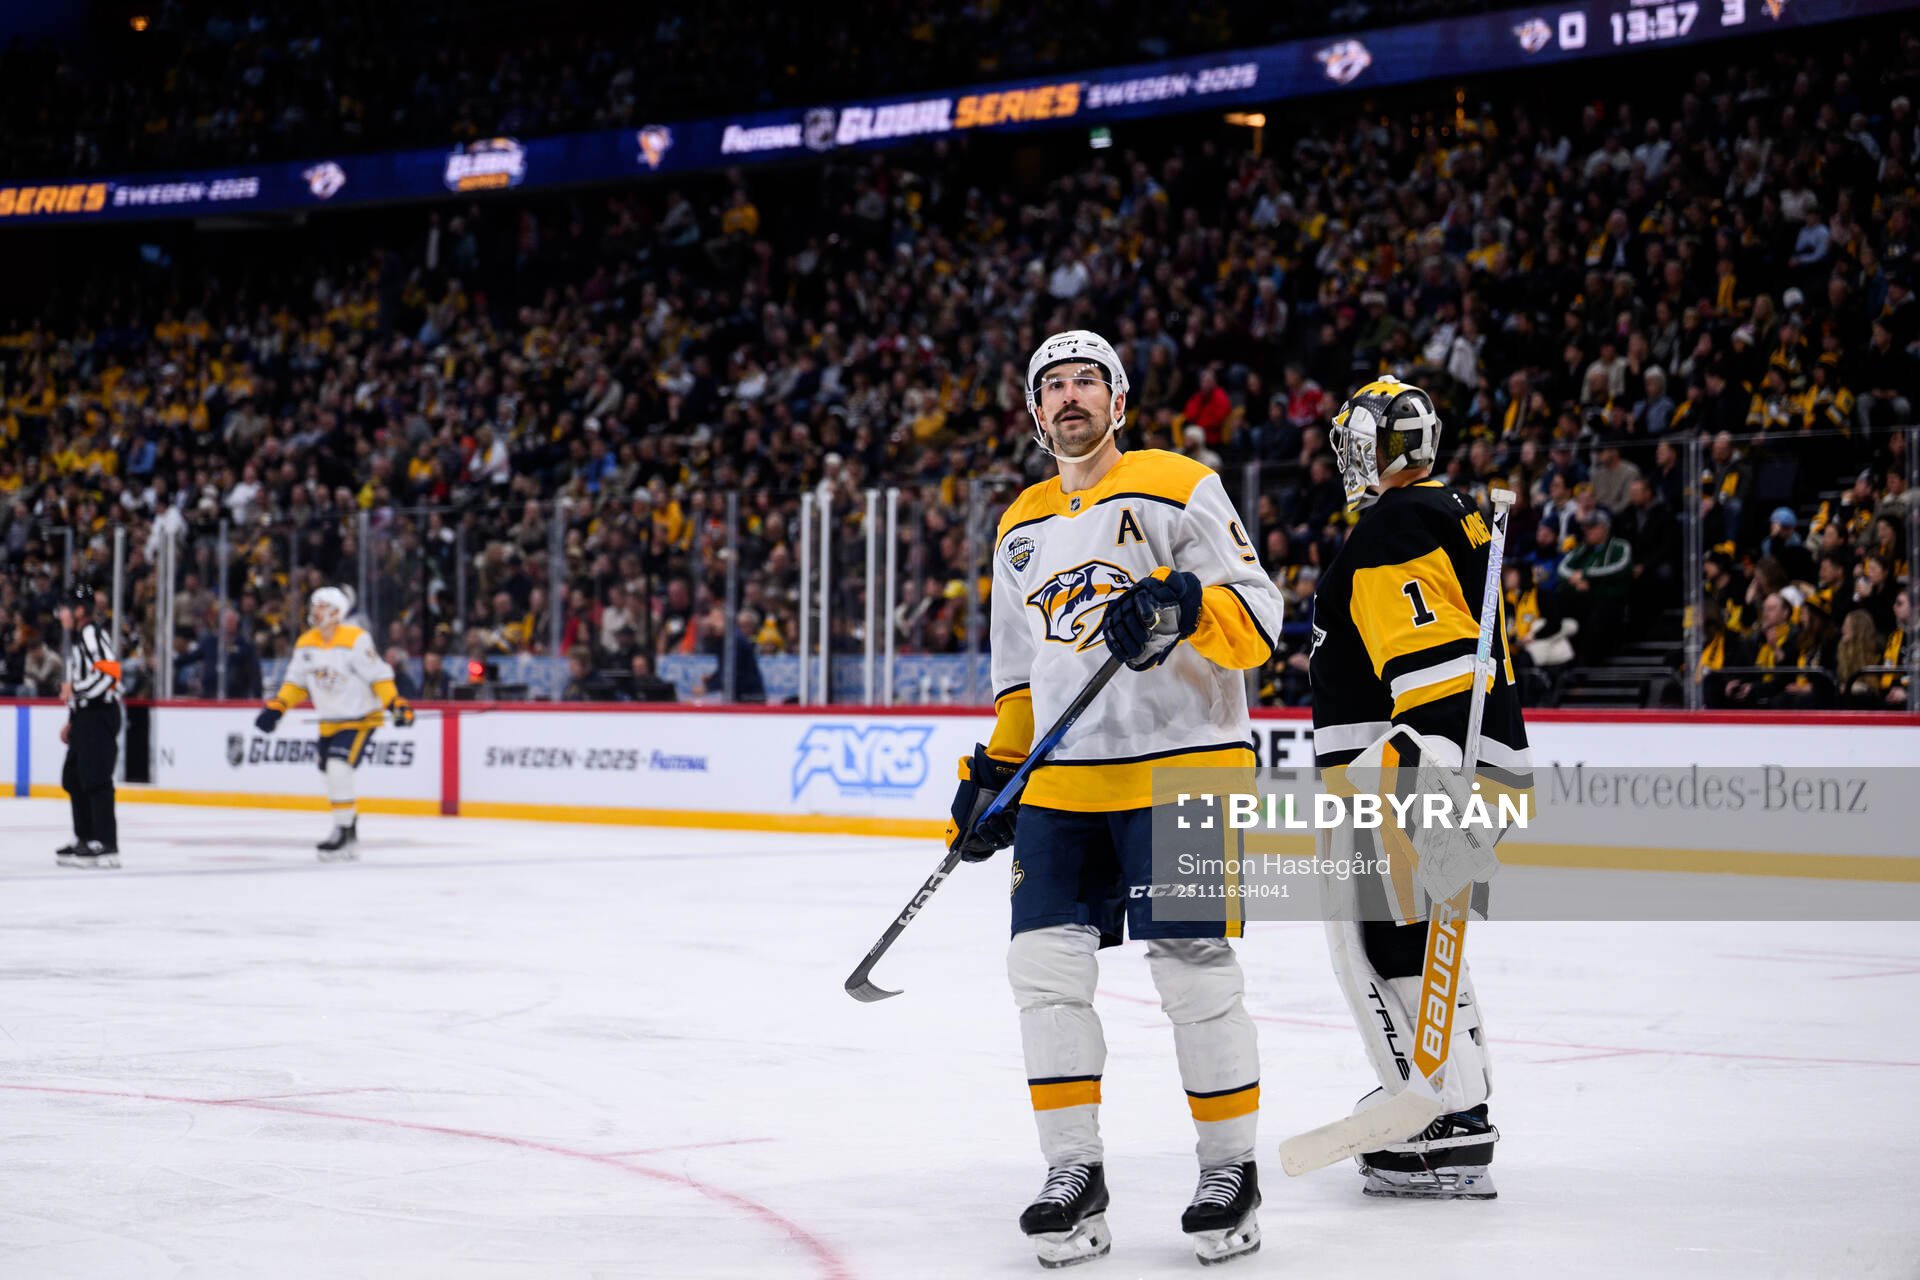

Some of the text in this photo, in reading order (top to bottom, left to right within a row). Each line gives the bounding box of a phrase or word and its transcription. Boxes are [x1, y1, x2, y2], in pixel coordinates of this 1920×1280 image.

[1558, 11, 1587, 50] 0
[1610, 1, 1699, 46] 13:57
[835, 98, 952, 145] GLOBAL
[954, 82, 1081, 128] SERIES
[0, 183, 107, 215] SERIES
[1048, 340, 1079, 350] CCM
[1116, 507, 1147, 547] A
[1228, 519, 1258, 565] 9
[1402, 580, 1437, 628] 1
[249, 737, 318, 764] GLOBA
[1550, 760, 1871, 815] Mercedes-Benz
[1368, 982, 1410, 1082] TRUE
